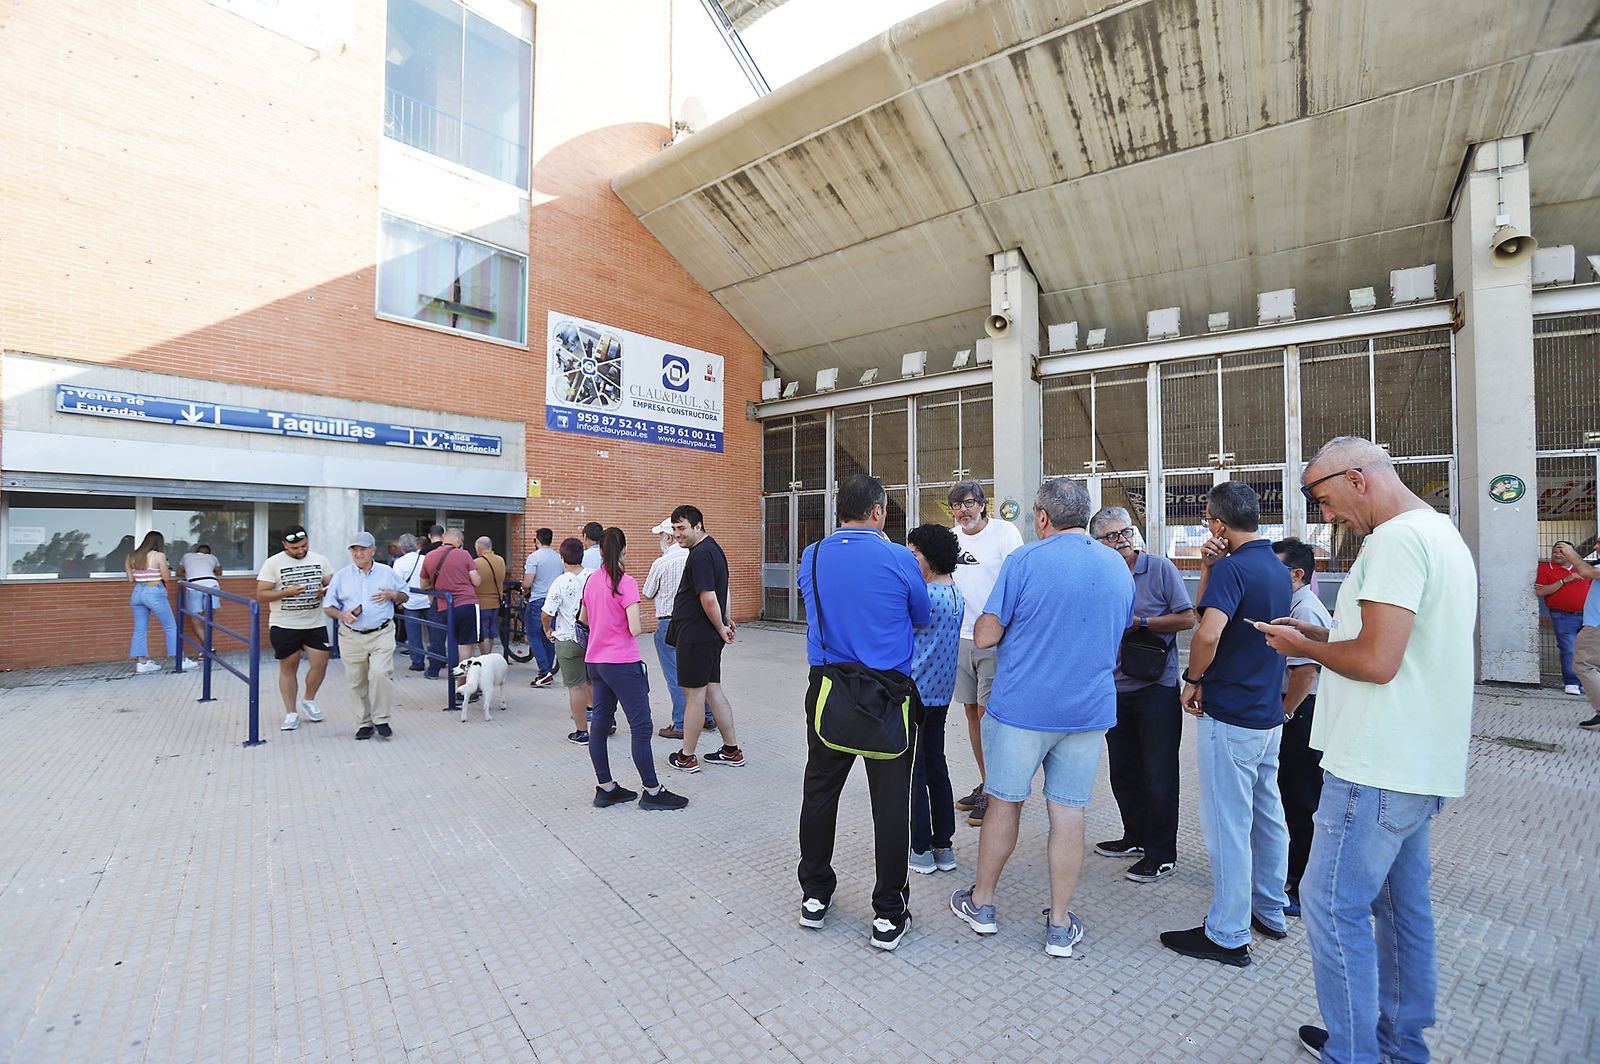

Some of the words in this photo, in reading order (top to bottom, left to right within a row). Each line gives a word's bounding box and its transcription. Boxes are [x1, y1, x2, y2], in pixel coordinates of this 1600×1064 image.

[77, 389, 121, 403] Venta
[126, 396, 145, 406] de
[76, 402, 146, 417] Entradas
[632, 400, 666, 412] EMPRESA
[666, 406, 718, 422] CONSTRUCTORA
[267, 412, 376, 439] Taquillas
[576, 422, 648, 438] info@clauypaul.es
[577, 412, 599, 424] 959
[602, 416, 616, 426] 87
[618, 418, 632, 429] 52
[634, 422, 648, 430] 41
[657, 424, 675, 435] 959
[678, 428, 689, 437] 61
[692, 430, 703, 440] 00
[706, 433, 716, 441] 11
[444, 432, 470, 442] Salida
[658, 435, 716, 448] www.clauypaul.es
[453, 443, 500, 453] Incidencias
